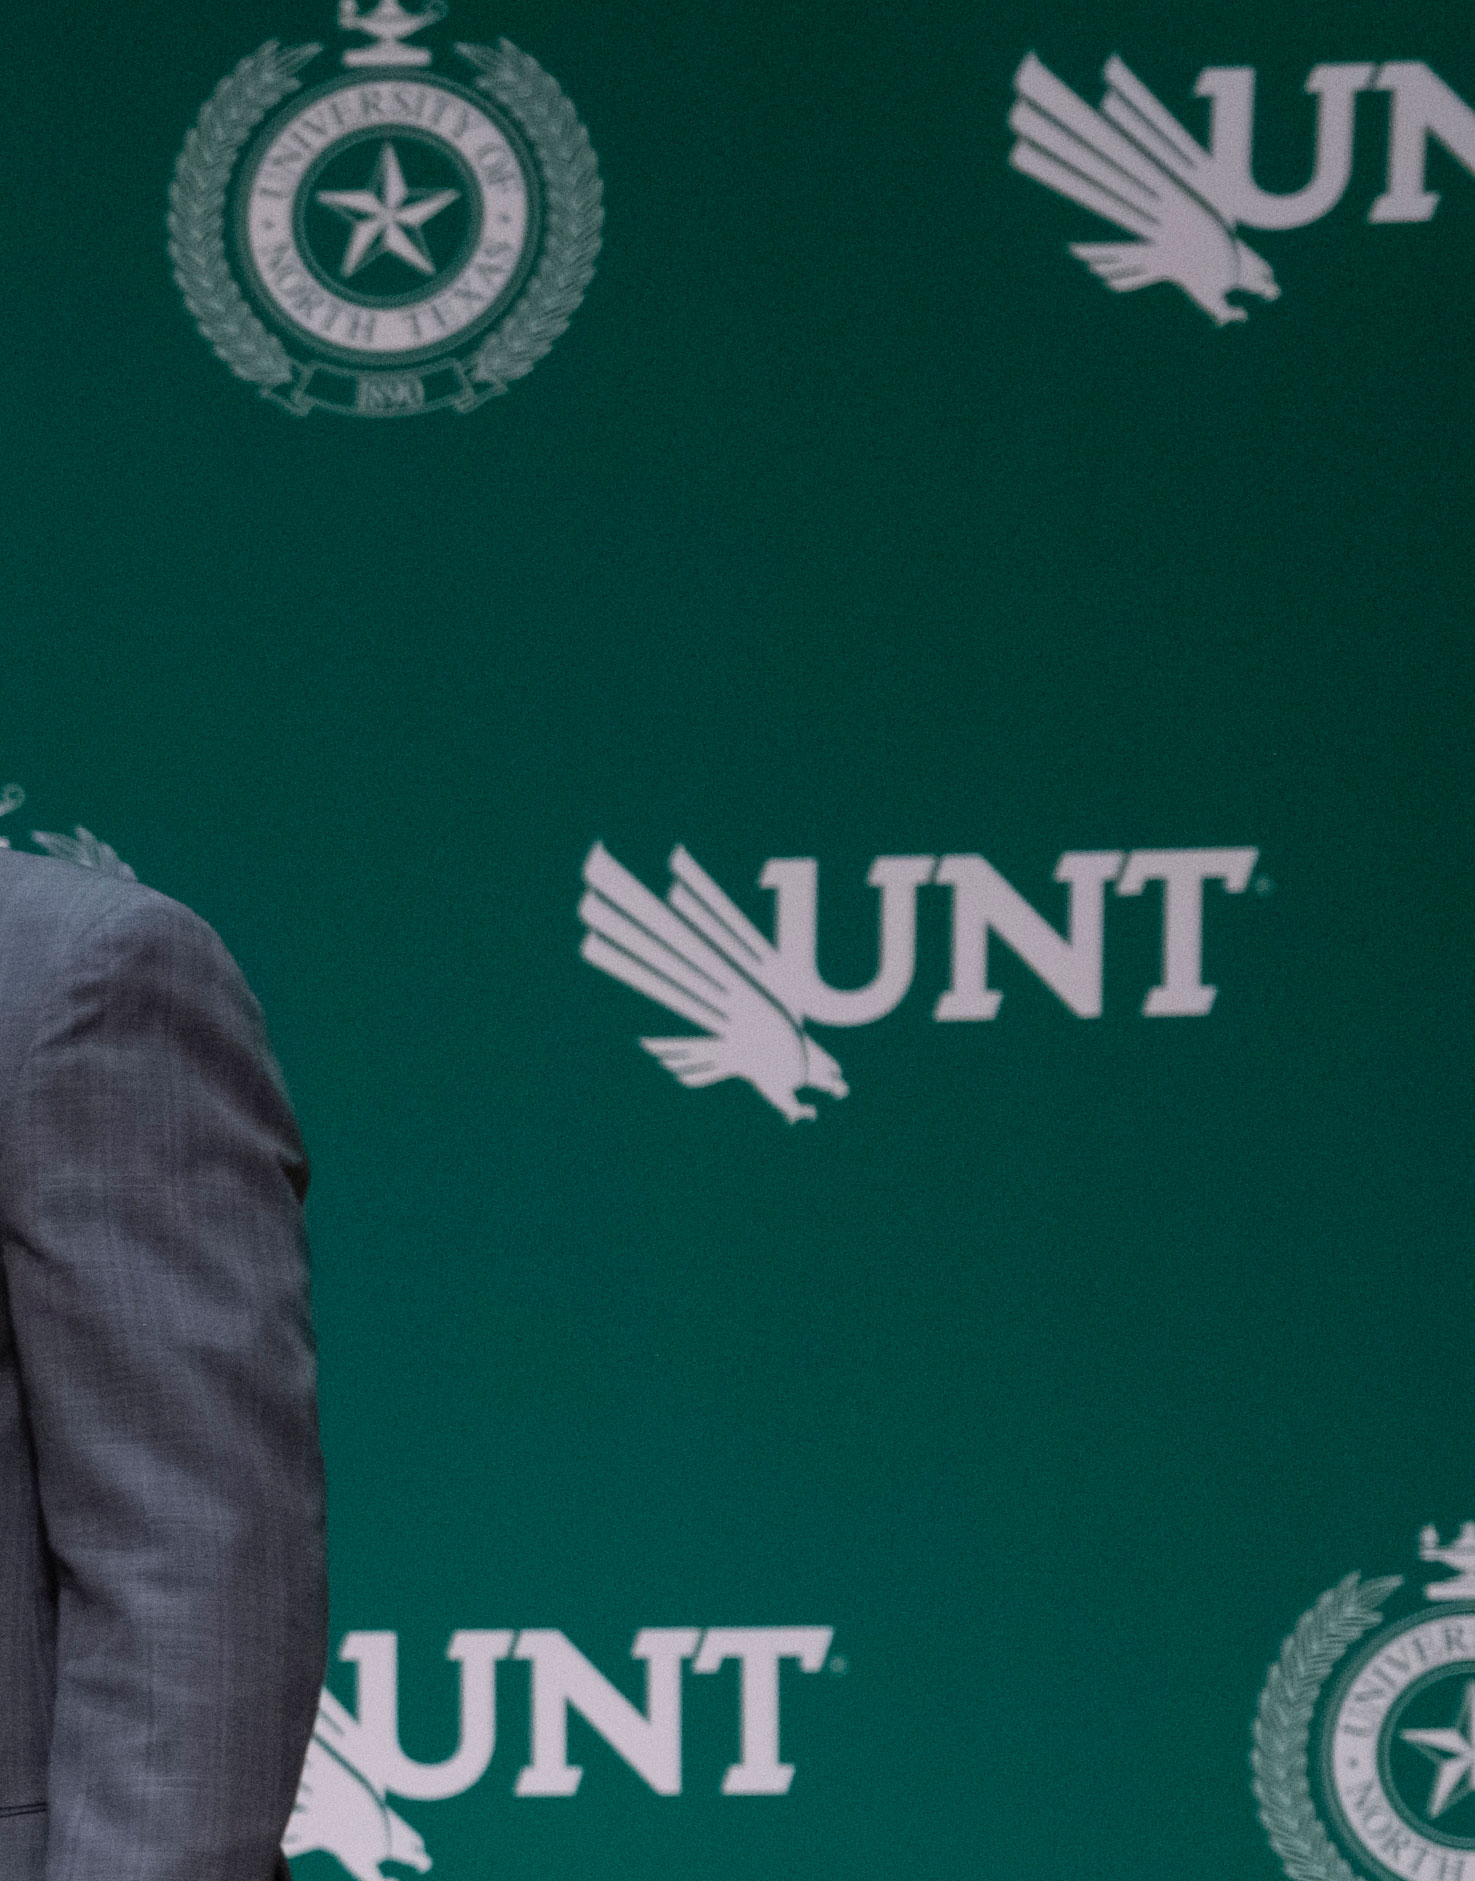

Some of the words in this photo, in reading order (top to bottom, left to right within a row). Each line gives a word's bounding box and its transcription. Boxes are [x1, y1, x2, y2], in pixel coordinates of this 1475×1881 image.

[259, 88, 474, 197] UNIVERSITY
[476, 143, 516, 188] OF
[263, 244, 376, 343] NORTH
[404, 241, 515, 341] TEXAS
[764, 847, 1260, 1027] UNT
[338, 1625, 834, 1800] UNT
